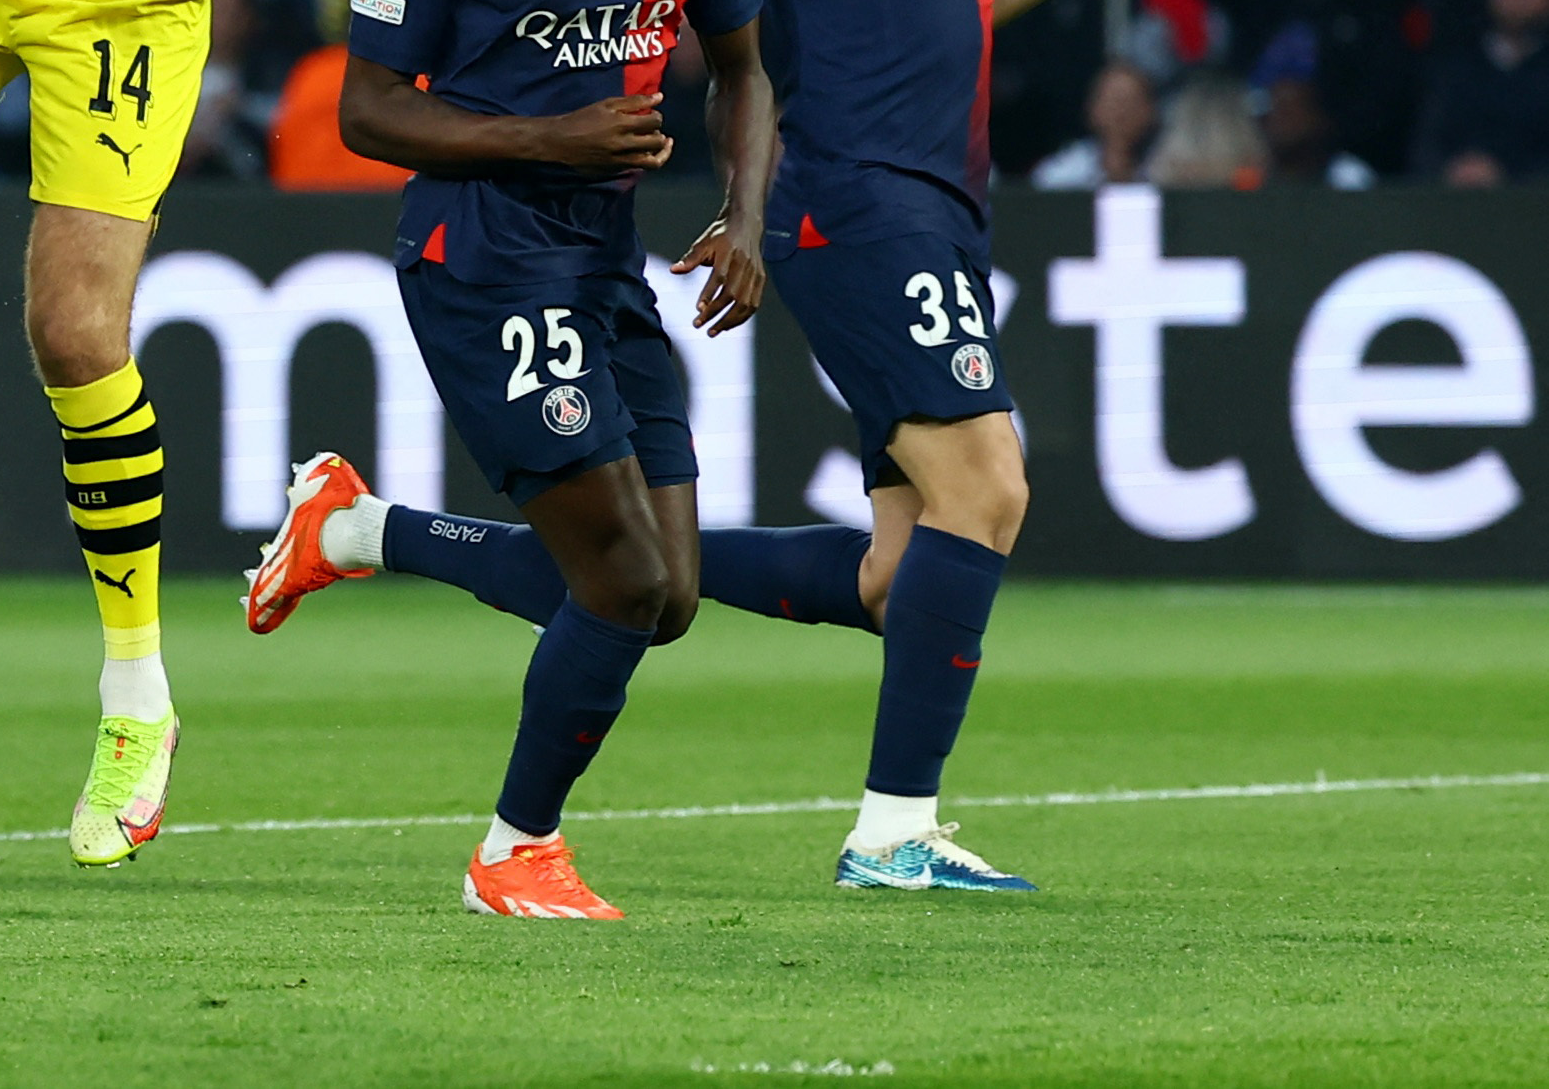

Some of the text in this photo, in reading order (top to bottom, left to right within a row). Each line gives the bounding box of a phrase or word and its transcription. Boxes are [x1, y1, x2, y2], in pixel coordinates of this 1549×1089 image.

[515, 0, 676, 50] QATAR
[553, 30, 664, 68] AIRWAYS
[89, 39, 154, 129] 14
[904, 270, 991, 347] 35
[129, 183, 1536, 542] mte
[501, 308, 593, 402] 25
[546, 388, 576, 407] PARIS
[78, 491, 108, 504] 09
[428, 519, 488, 543] PARIS
